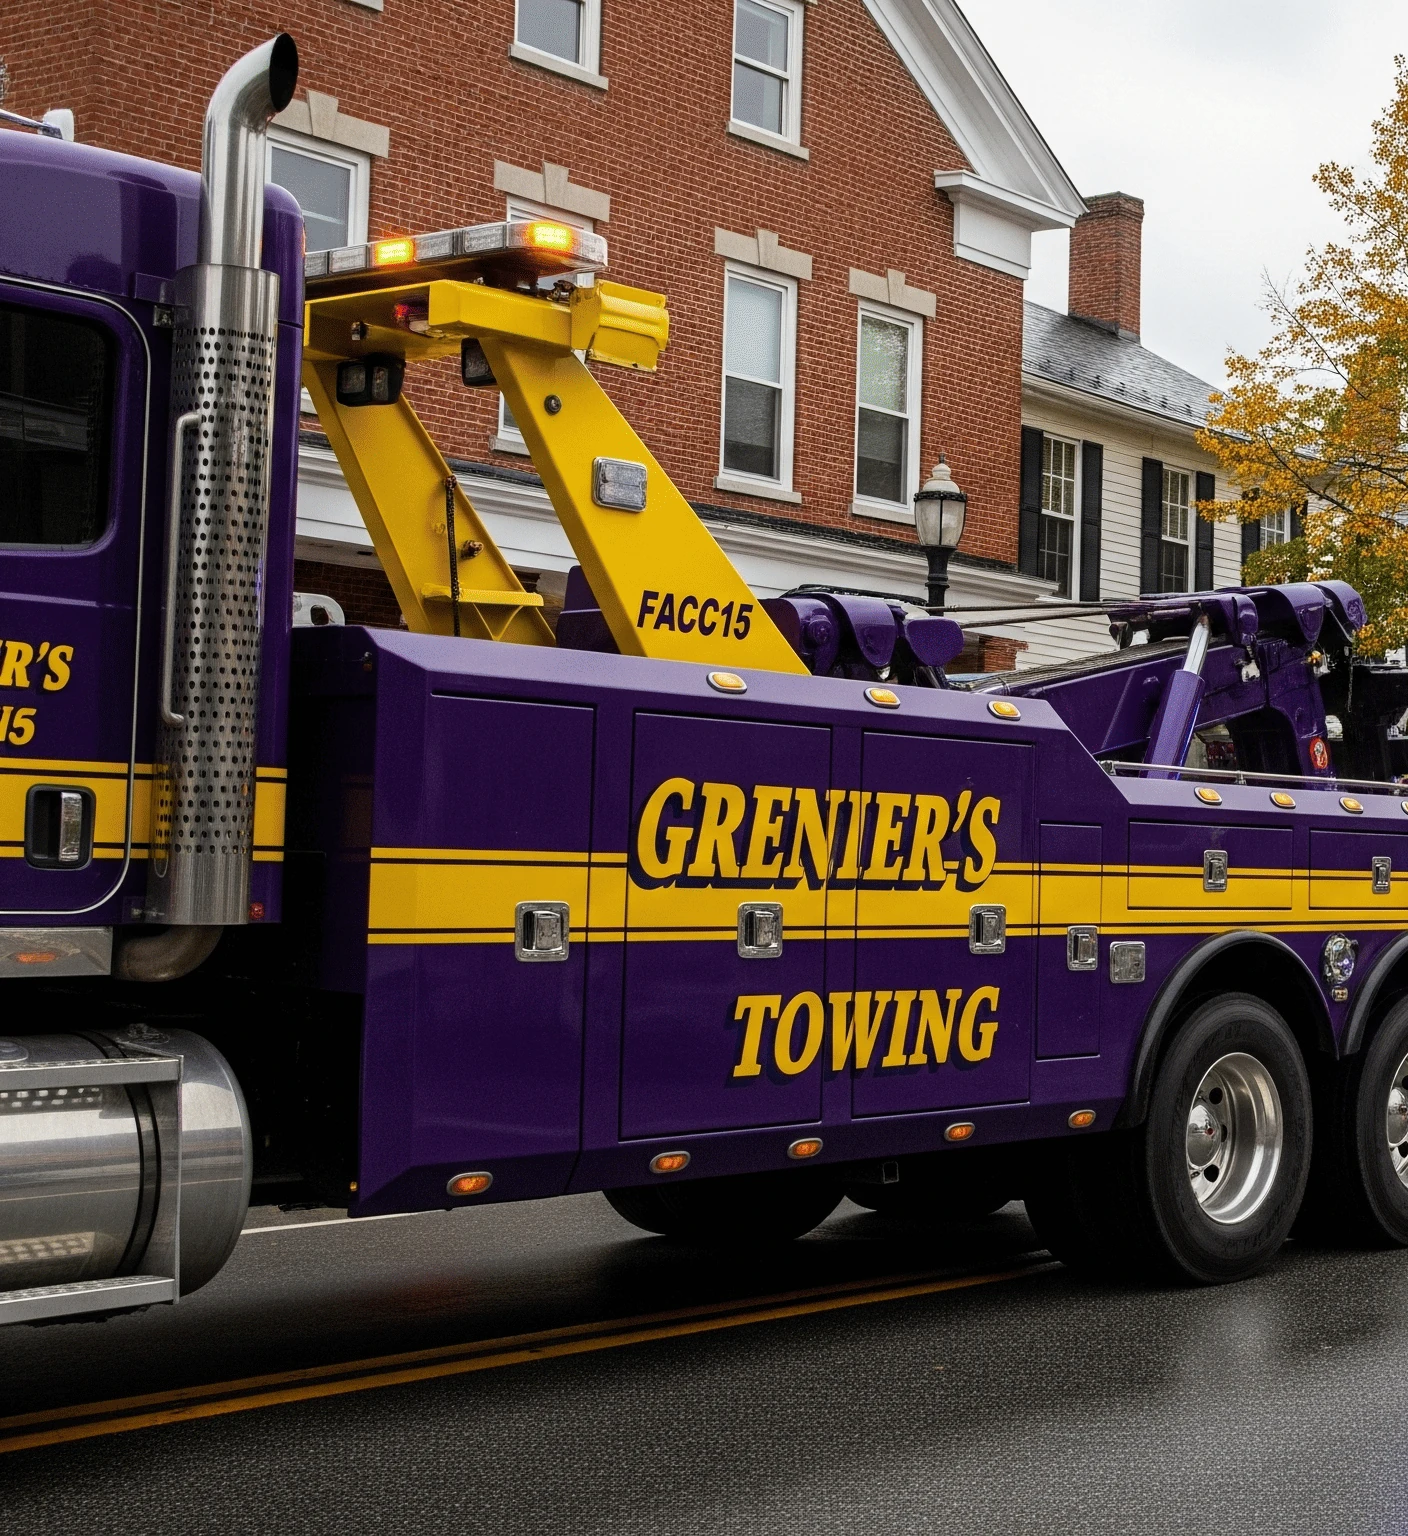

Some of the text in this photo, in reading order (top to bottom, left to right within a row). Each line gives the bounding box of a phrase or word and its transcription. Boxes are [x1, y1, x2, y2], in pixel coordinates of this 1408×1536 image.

[636, 589, 754, 641] FACC15
[635, 776, 1001, 886] GRENIER'S
[732, 985, 1001, 1078] TOWING
